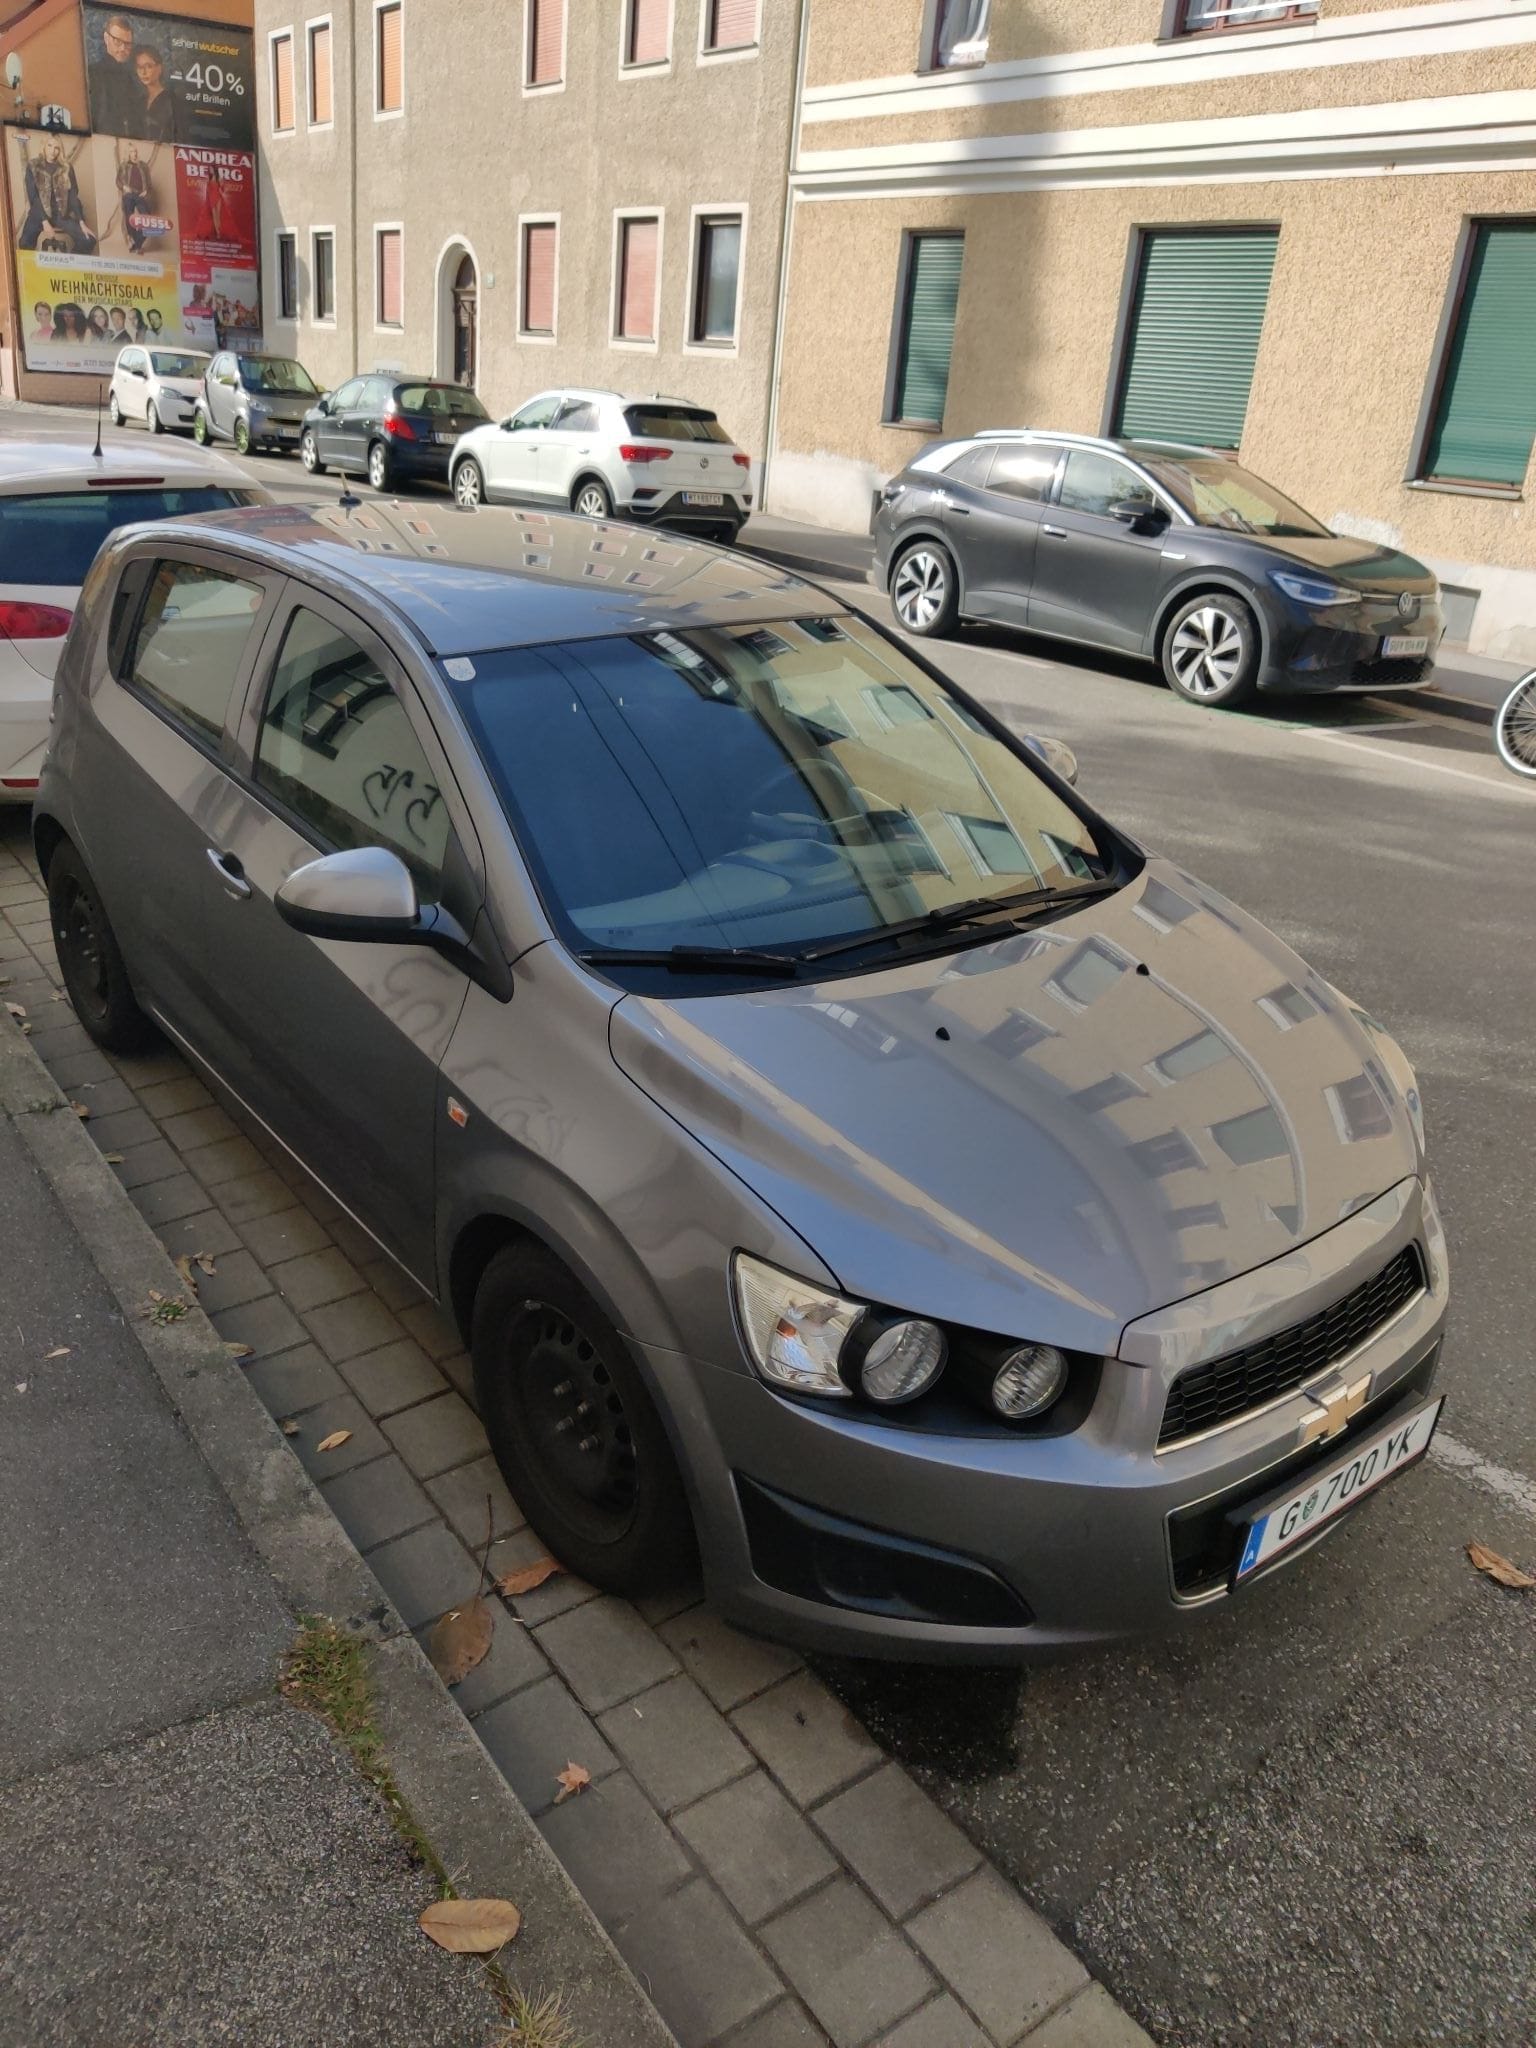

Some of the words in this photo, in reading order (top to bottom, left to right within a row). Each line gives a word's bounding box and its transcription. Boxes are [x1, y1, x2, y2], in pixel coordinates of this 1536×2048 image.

[185, 92, 200, 101] auf
[202, 94, 231, 106] Brillen
[176, 148, 252, 168] ANDREA
[134, 217, 172, 229] FUSSL
[50, 278, 154, 300] WEIHNACHTSGALA
[1279, 1501, 1301, 1540] G
[1321, 1448, 1380, 1513] 700
[1384, 1419, 1420, 1469] YK
